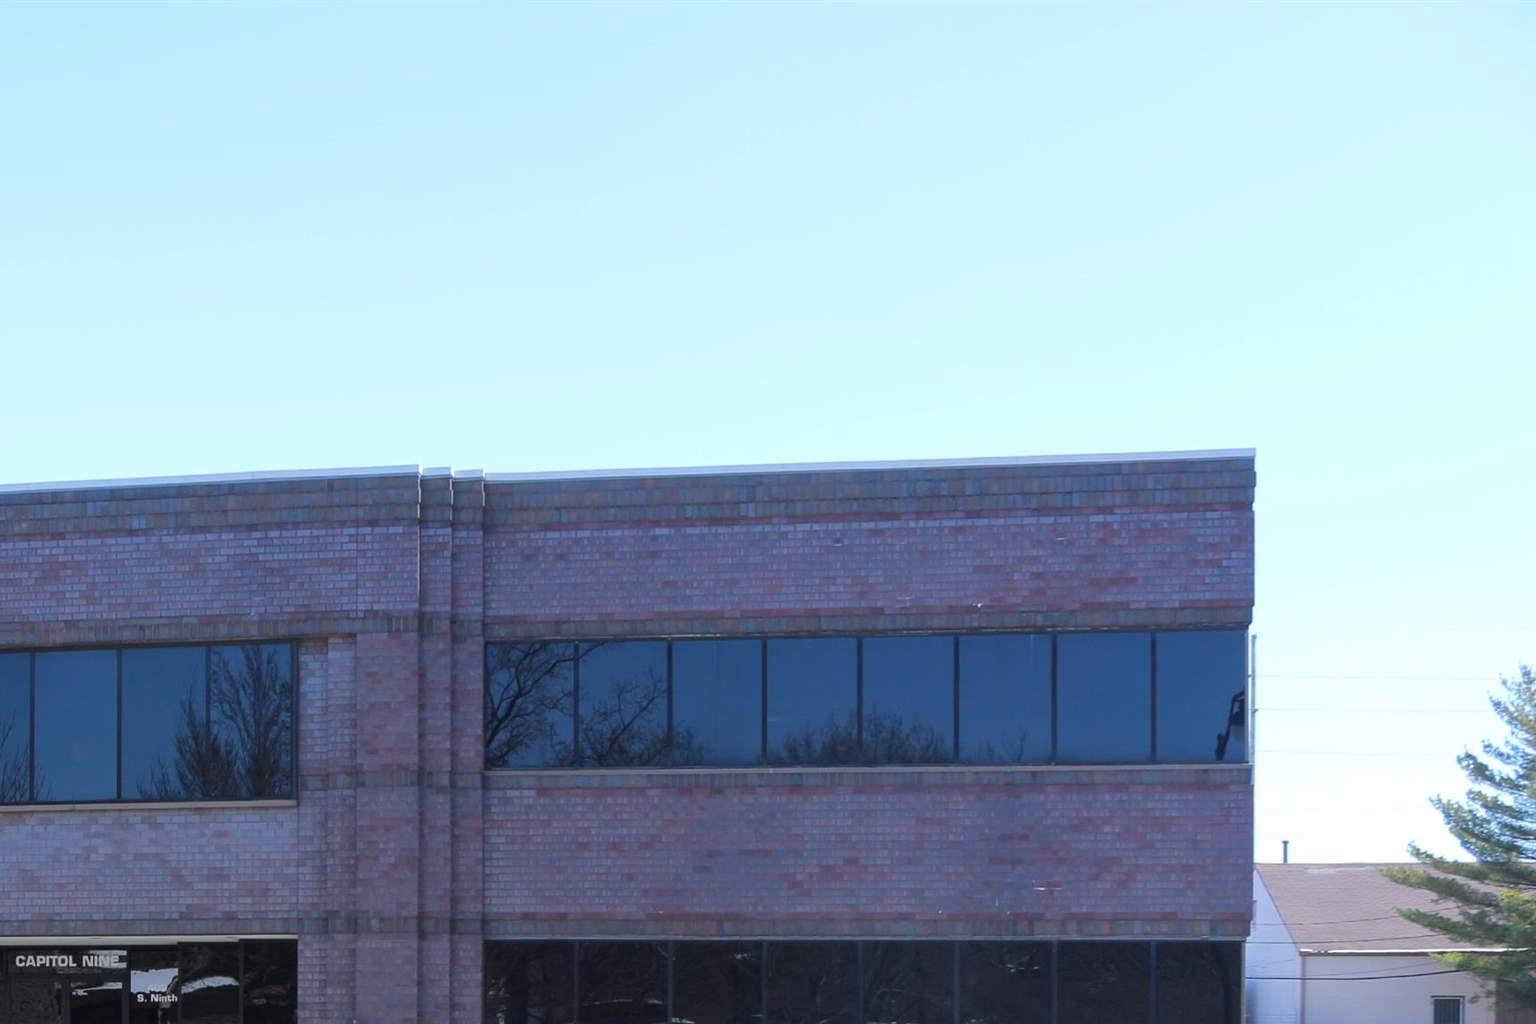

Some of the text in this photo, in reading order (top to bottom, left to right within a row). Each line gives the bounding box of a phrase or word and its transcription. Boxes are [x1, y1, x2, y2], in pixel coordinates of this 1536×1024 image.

[15, 955, 120, 968] CAPITOL NINE
[137, 993, 178, 1002] S. Ninth
